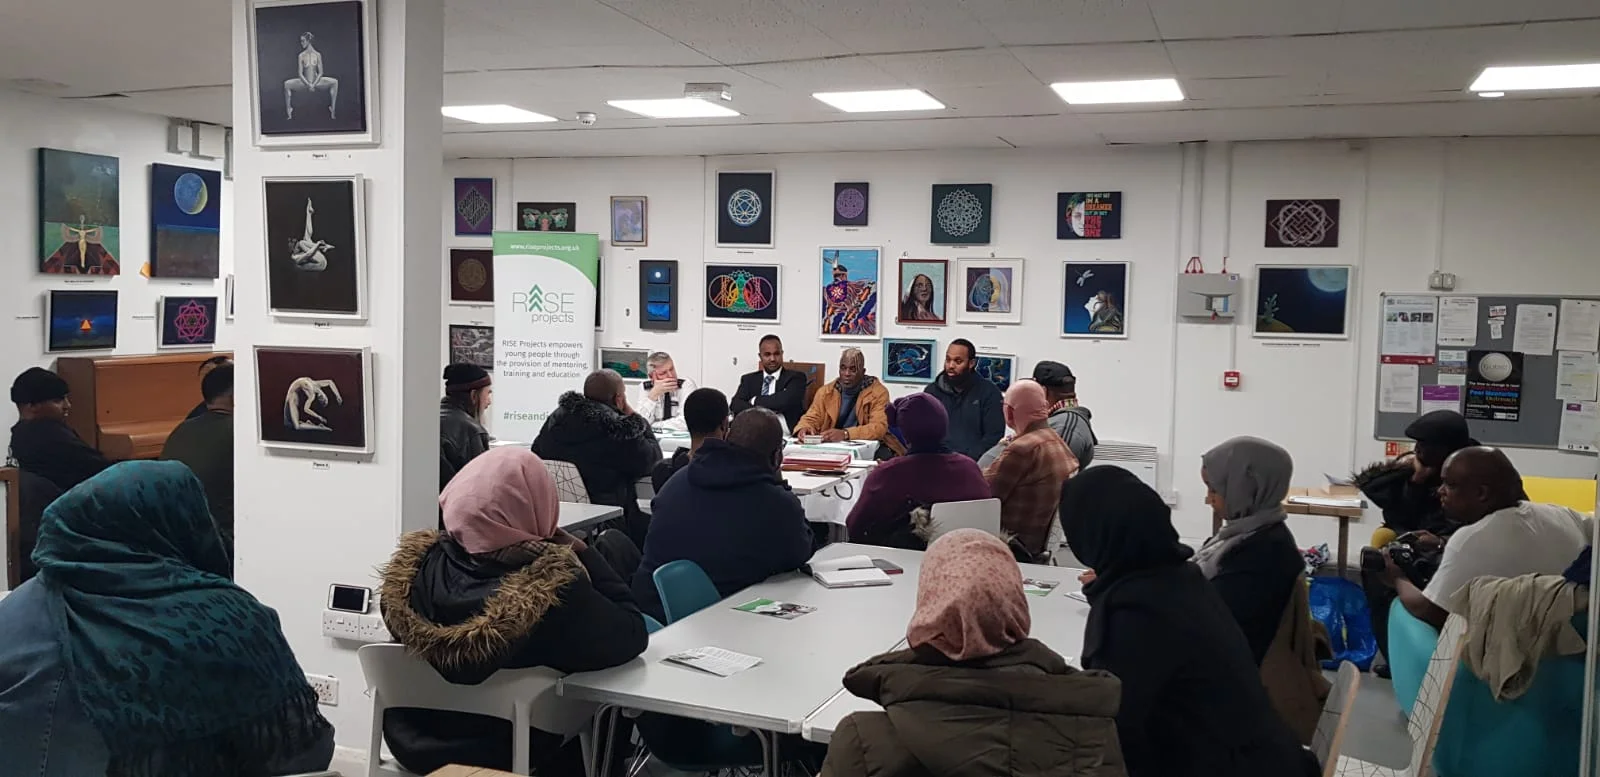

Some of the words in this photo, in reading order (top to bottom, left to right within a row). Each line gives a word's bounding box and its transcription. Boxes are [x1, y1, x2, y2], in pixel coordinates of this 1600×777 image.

[510, 244, 580, 252] www.riseprojects.org.uk
[531, 312, 575, 324] projects
[519, 340, 547, 349] Projects
[553, 351, 580, 359] through
[509, 360, 542, 368] provision
[552, 361, 588, 369] mentoring,
[503, 370, 530, 378] training
